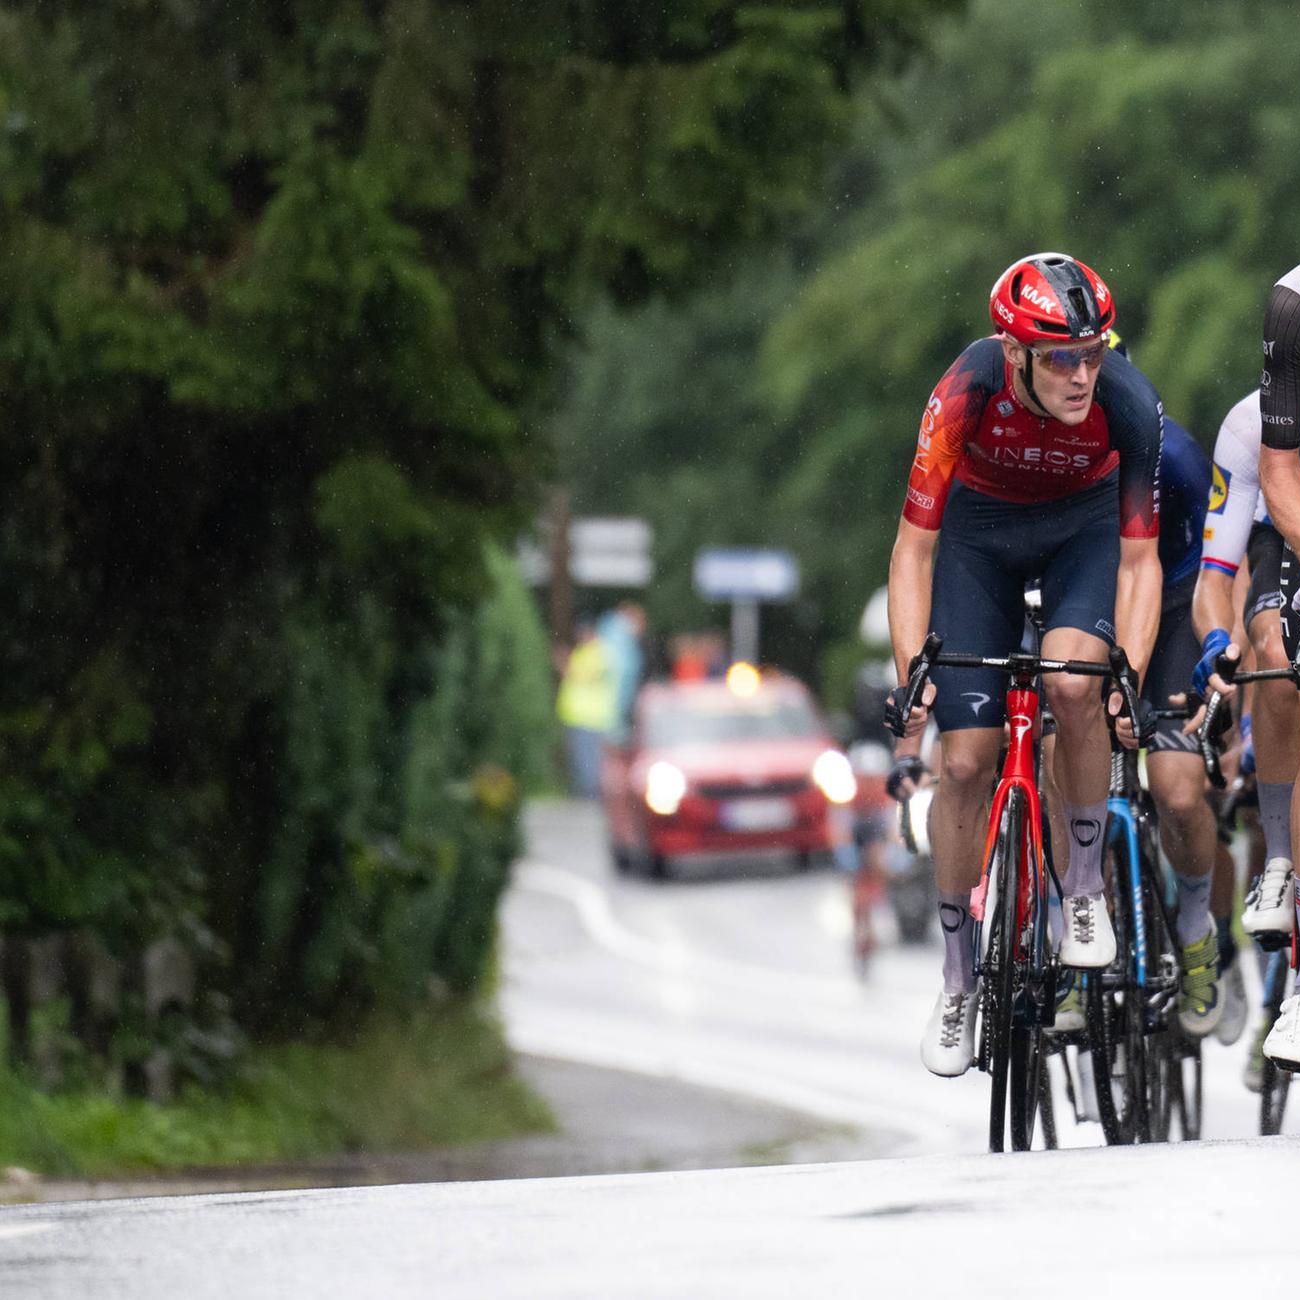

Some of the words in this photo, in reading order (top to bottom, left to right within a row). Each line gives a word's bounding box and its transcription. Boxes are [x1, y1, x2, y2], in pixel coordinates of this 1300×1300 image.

[993, 299, 1015, 325] INEOS
[1020, 283, 1057, 315] KASK
[993, 446, 1091, 468] INEOS
